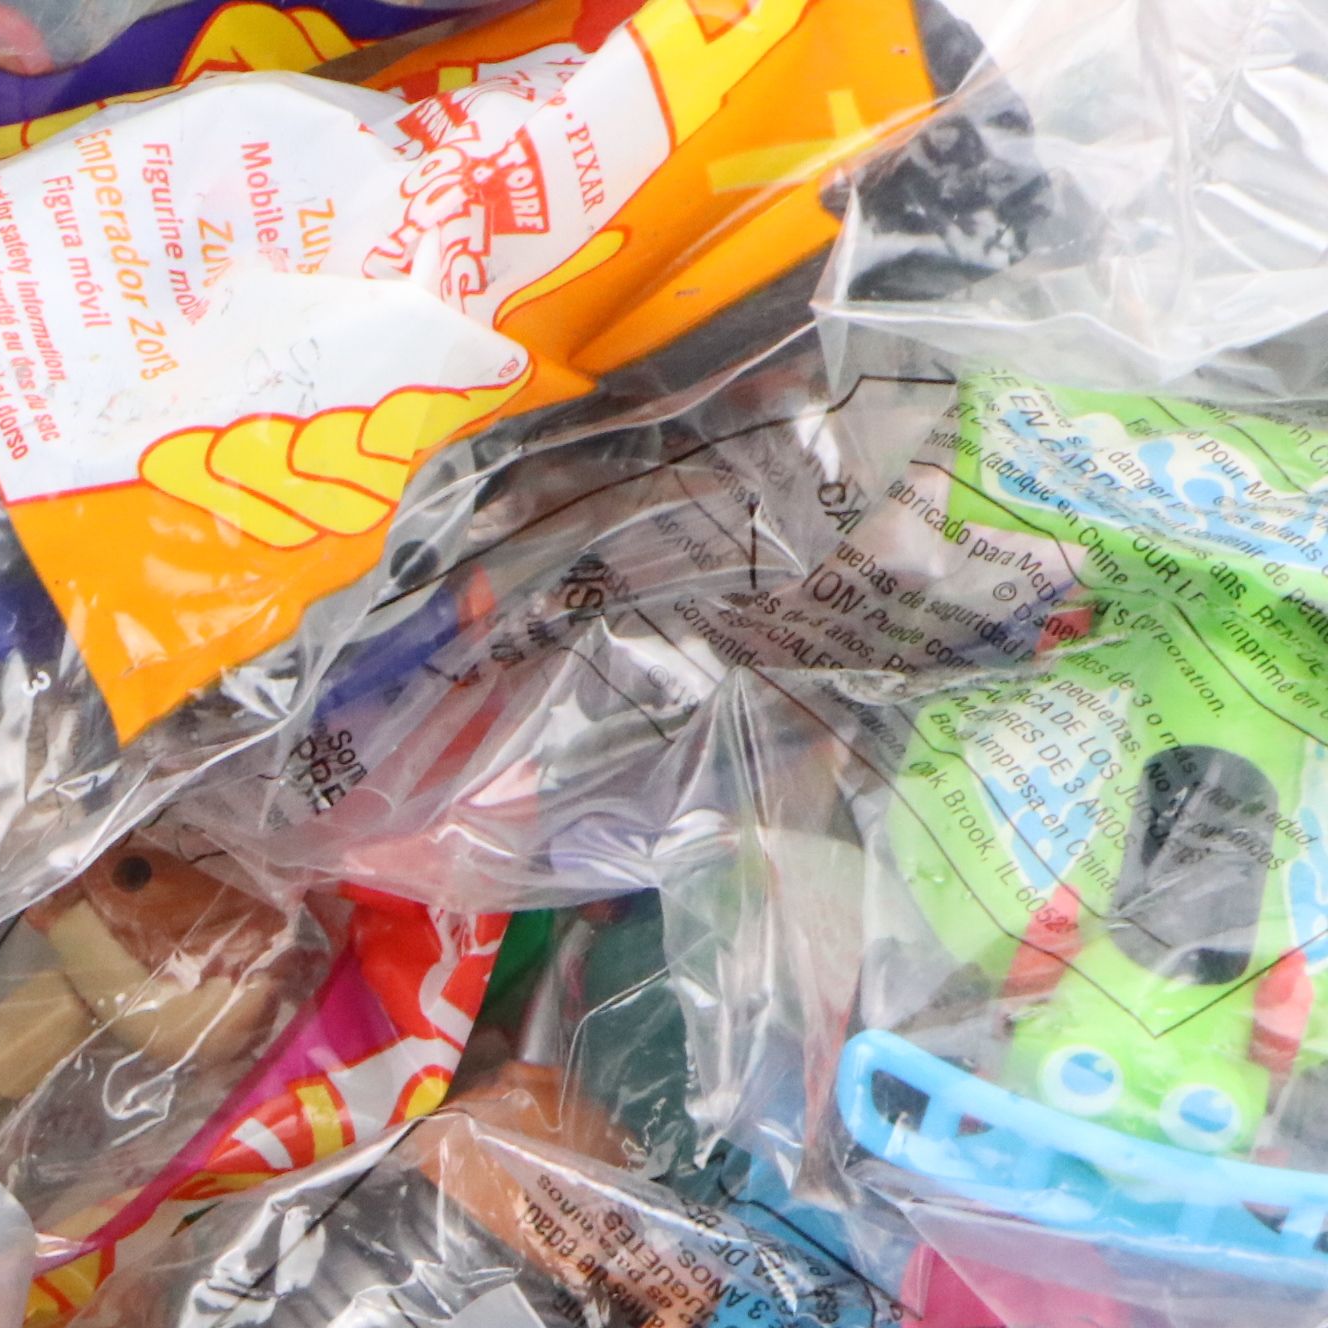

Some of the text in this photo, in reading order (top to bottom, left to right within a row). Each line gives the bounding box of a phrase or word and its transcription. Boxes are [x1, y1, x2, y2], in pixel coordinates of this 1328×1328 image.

[143, 143, 184, 260] Figurine
[241, 142, 284, 245] Mobile
[566, 123, 605, 213] PIXAR
[0, 223, 32, 275] safety
[43, 176, 112, 327] Figura móvil
[74, 128, 182, 381] Emperador Zorg
[3, 332, 23, 351] au
[35, 413, 61, 441] sac
[1108, 447, 1173, 503] danger
[1196, 440, 1247, 480] pour
[1056, 499, 1130, 587] en Chine
[1209, 562, 1248, 608] ans.
[975, 733, 1069, 839] impresa en
[1064, 777, 1085, 794] 3
[1078, 735, 1123, 780] LOS
[943, 790, 996, 862] Brook,
